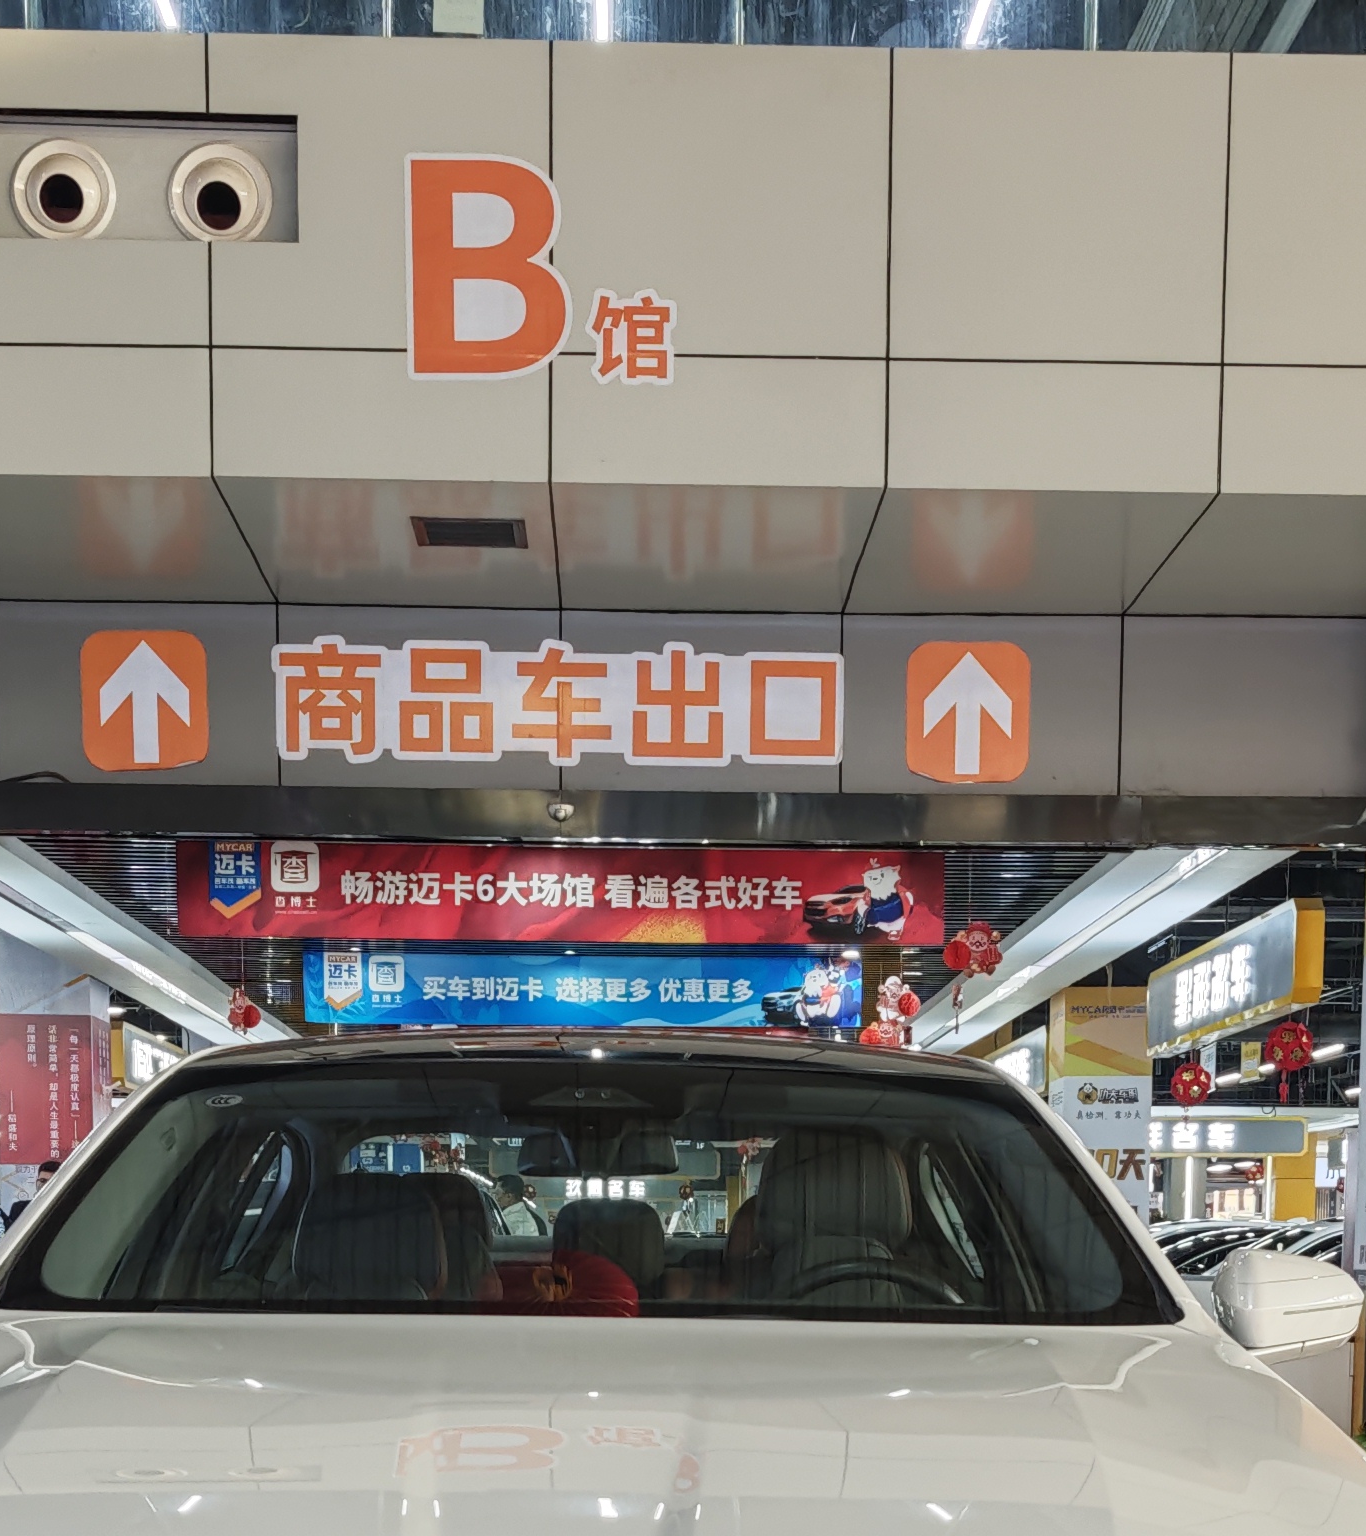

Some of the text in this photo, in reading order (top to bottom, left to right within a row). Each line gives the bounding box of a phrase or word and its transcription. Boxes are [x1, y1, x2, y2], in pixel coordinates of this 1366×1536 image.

[277, 640, 842, 761] 商品车出口
[214, 842, 254, 852] MYCAR
[214, 854, 257, 876] 迈卡
[275, 896, 318, 908] 查博士
[340, 870, 803, 911] 畅游迈卡6大场馆 看遍各式好车
[328, 964, 358, 979] 迈卡
[423, 975, 754, 1004] 买车到迈卡 选择更多 优惠更多
[1088, 1148, 1146, 1181] 0天
